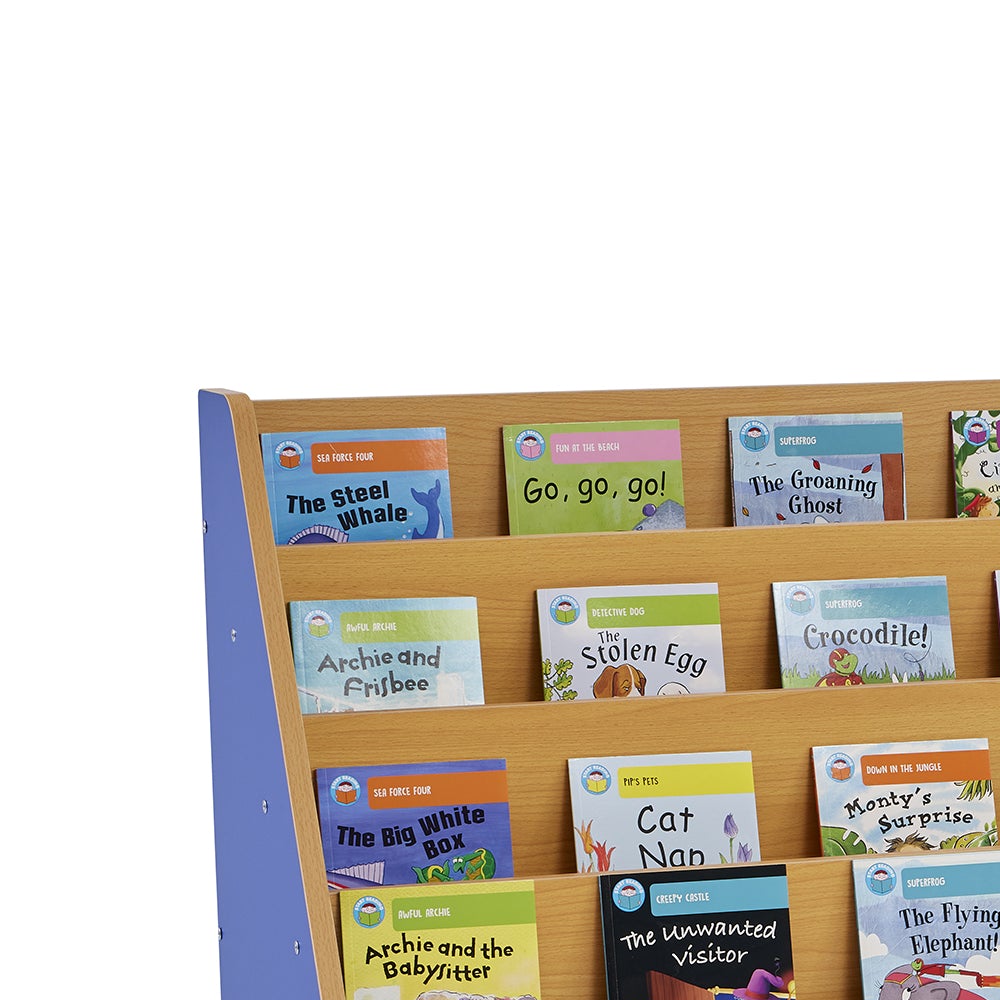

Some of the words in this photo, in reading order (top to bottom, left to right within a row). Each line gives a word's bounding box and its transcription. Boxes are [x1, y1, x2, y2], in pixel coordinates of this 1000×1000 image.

[741, 422, 751, 434] START
[752, 422, 770, 435] READING
[516, 430, 526, 443] START
[527, 430, 544, 444] READING
[780, 436, 816, 446] SUPERFROG
[556, 444, 569, 453] FUN
[572, 444, 580, 452] AT
[583, 443, 595, 452] THE
[598, 442, 619, 451] BEACH
[317, 453, 330, 462] SEA
[333, 453, 353, 462] FORCE
[356, 452, 373, 461] FOUR
[524, 477, 568, 504] Go,
[579, 476, 617, 503] go,
[628, 471, 666, 503] go!
[749, 476, 783, 496] The
[791, 469, 877, 499] Groaning
[287, 495, 326, 514] The
[330, 480, 389, 507] Steel
[789, 495, 842, 514] Ghost
[337, 503, 408, 531] Whale
[552, 596, 561, 608] START
[562, 596, 579, 608] READING
[825, 599, 862, 609] SUPERFROG
[592, 608, 627, 617] DETECTIVE
[630, 607, 644, 616] DOG
[347, 623, 369, 632] AWFUL
[372, 622, 396, 631] ARCHIE
[598, 630, 619, 644] The
[803, 622, 928, 651] Crocodile!
[318, 647, 393, 674] Archie
[398, 646, 441, 668] and
[580, 638, 656, 669] Stolen
[664, 644, 707, 677] Egg
[583, 766, 593, 778] START
[593, 766, 610, 778] READING
[867, 766, 887, 774] DOWN
[889, 764, 898, 774] IN
[900, 764, 913, 773] THE
[916, 763, 941, 772] JUNGLE
[624, 777, 641, 786] PIP'S
[643, 776, 658, 785] PETS
[374, 789, 387, 797] SEA
[390, 787, 410, 796] FORCE
[413, 786, 431, 795] FOUR
[844, 787, 931, 820] Monty's
[338, 826, 374, 847] The
[382, 826, 416, 847] Big
[417, 805, 485, 837] White
[637, 805, 694, 833] Cat
[877, 807, 973, 834] Surprise
[423, 834, 465, 859] Box
[867, 865, 876, 877] START
[878, 864, 895, 878] READING
[615, 880, 624, 893] START
[626, 879, 643, 893] READING
[907, 877, 945, 887] SUPERFROG
[355, 898, 365, 910] START
[366, 897, 383, 910] READING
[657, 894, 683, 903] CREEPY
[686, 892, 709, 902] CASTLE
[398, 909, 422, 919] AWFUL
[425, 907, 450, 917] ARCHIE
[899, 907, 933, 929] The
[620, 930, 656, 951] The
[911, 933, 998, 958] Elephant!
[365, 933, 434, 964] Archie
[438, 938, 476, 958] and
[480, 938, 513, 959] the
